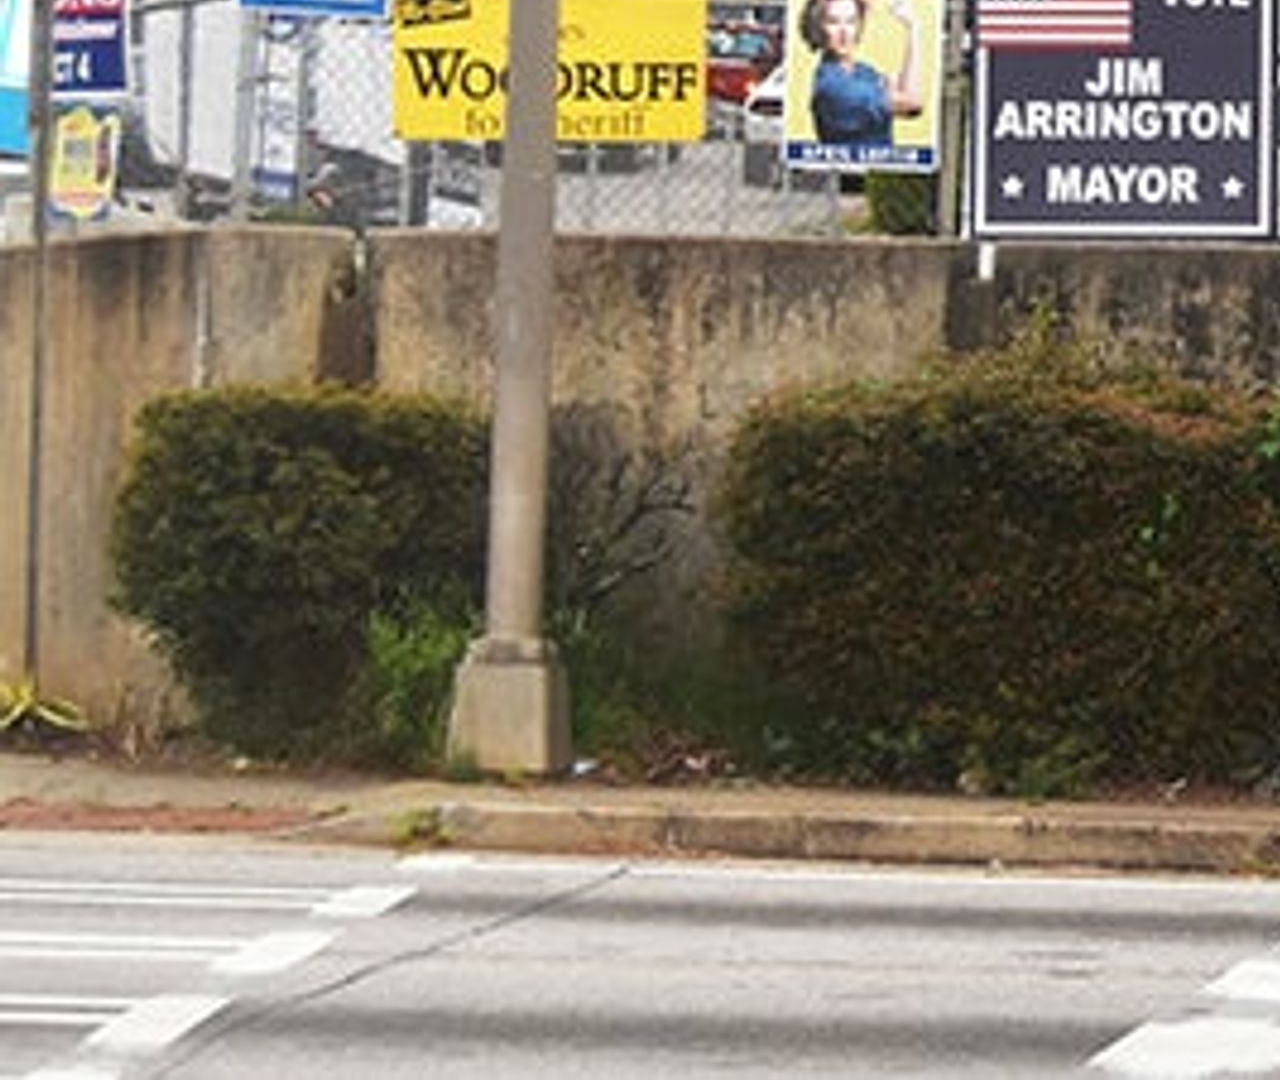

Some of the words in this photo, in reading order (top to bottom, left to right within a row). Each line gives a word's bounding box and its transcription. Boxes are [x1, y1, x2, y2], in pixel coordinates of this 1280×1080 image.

[402, 48, 698, 102] WORUFF
[1084, 58, 1163, 97] JIM
[993, 100, 1251, 141] ARRINGTON
[1046, 166, 1198, 204] MAYOR
